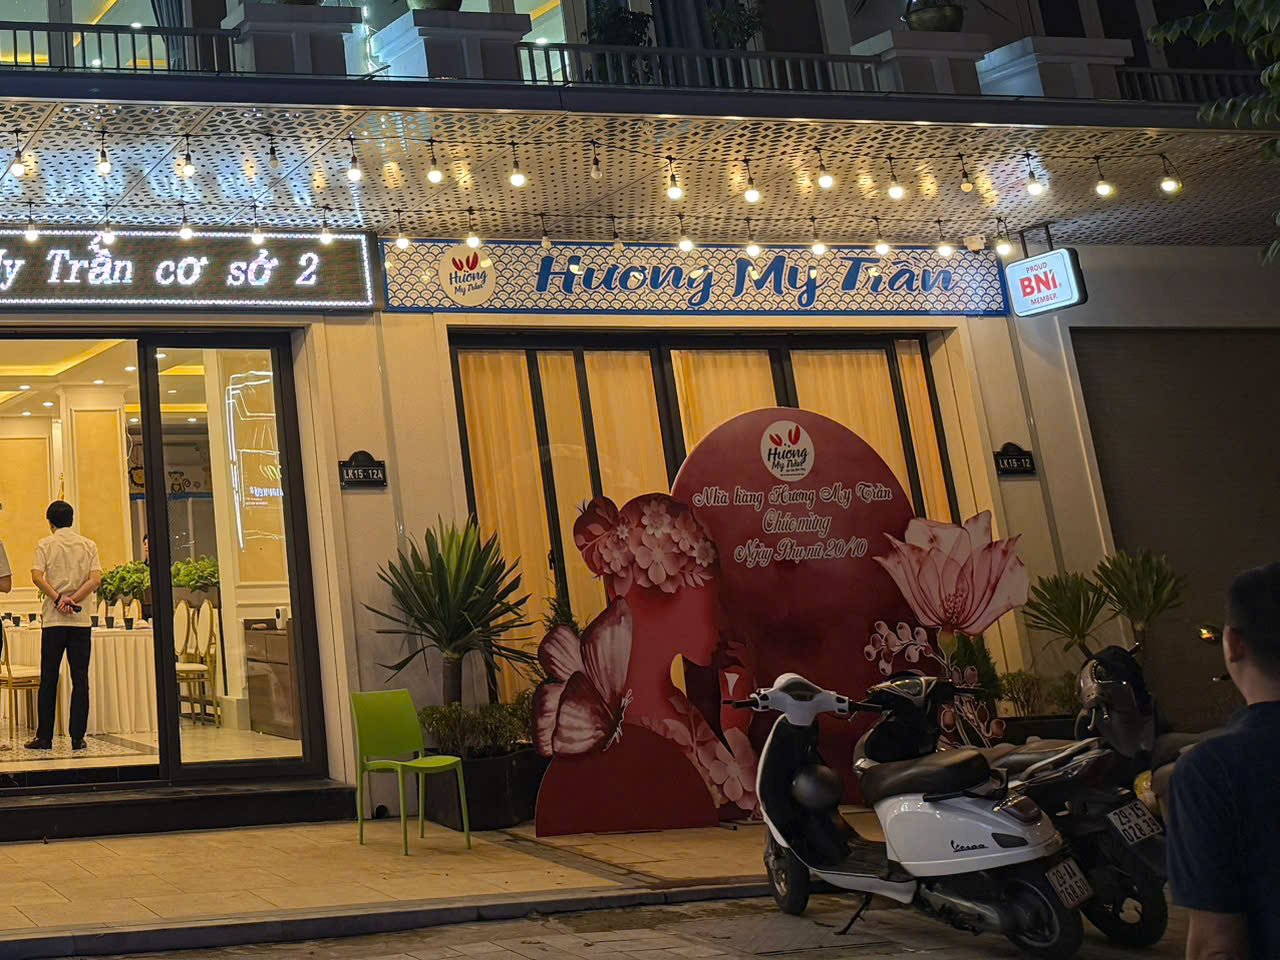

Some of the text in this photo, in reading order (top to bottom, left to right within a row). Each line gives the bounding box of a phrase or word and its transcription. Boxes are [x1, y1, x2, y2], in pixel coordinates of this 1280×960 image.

[155, 254, 210, 286] cơ
[226, 249, 280, 287] sở
[295, 251, 320, 286] 2
[1025, 261, 1049, 274] PROUD
[534, 254, 958, 308] Hương My Trần
[455, 285, 466, 296] My
[1030, 292, 1058, 306] MEMBER
[771, 460, 785, 472] My
[999, 458, 1032, 470] LK15-12
[692, 486, 729, 507] Nhà
[734, 486, 764, 511] hàng
[820, 482, 852, 509] My
[763, 509, 832, 538] Chúc mừng
[734, 538, 773, 568] Ngày
[774, 537, 805, 563] Phụ
[824, 536, 868, 560] 20/10
[950, 839, 989, 853] Vespa
